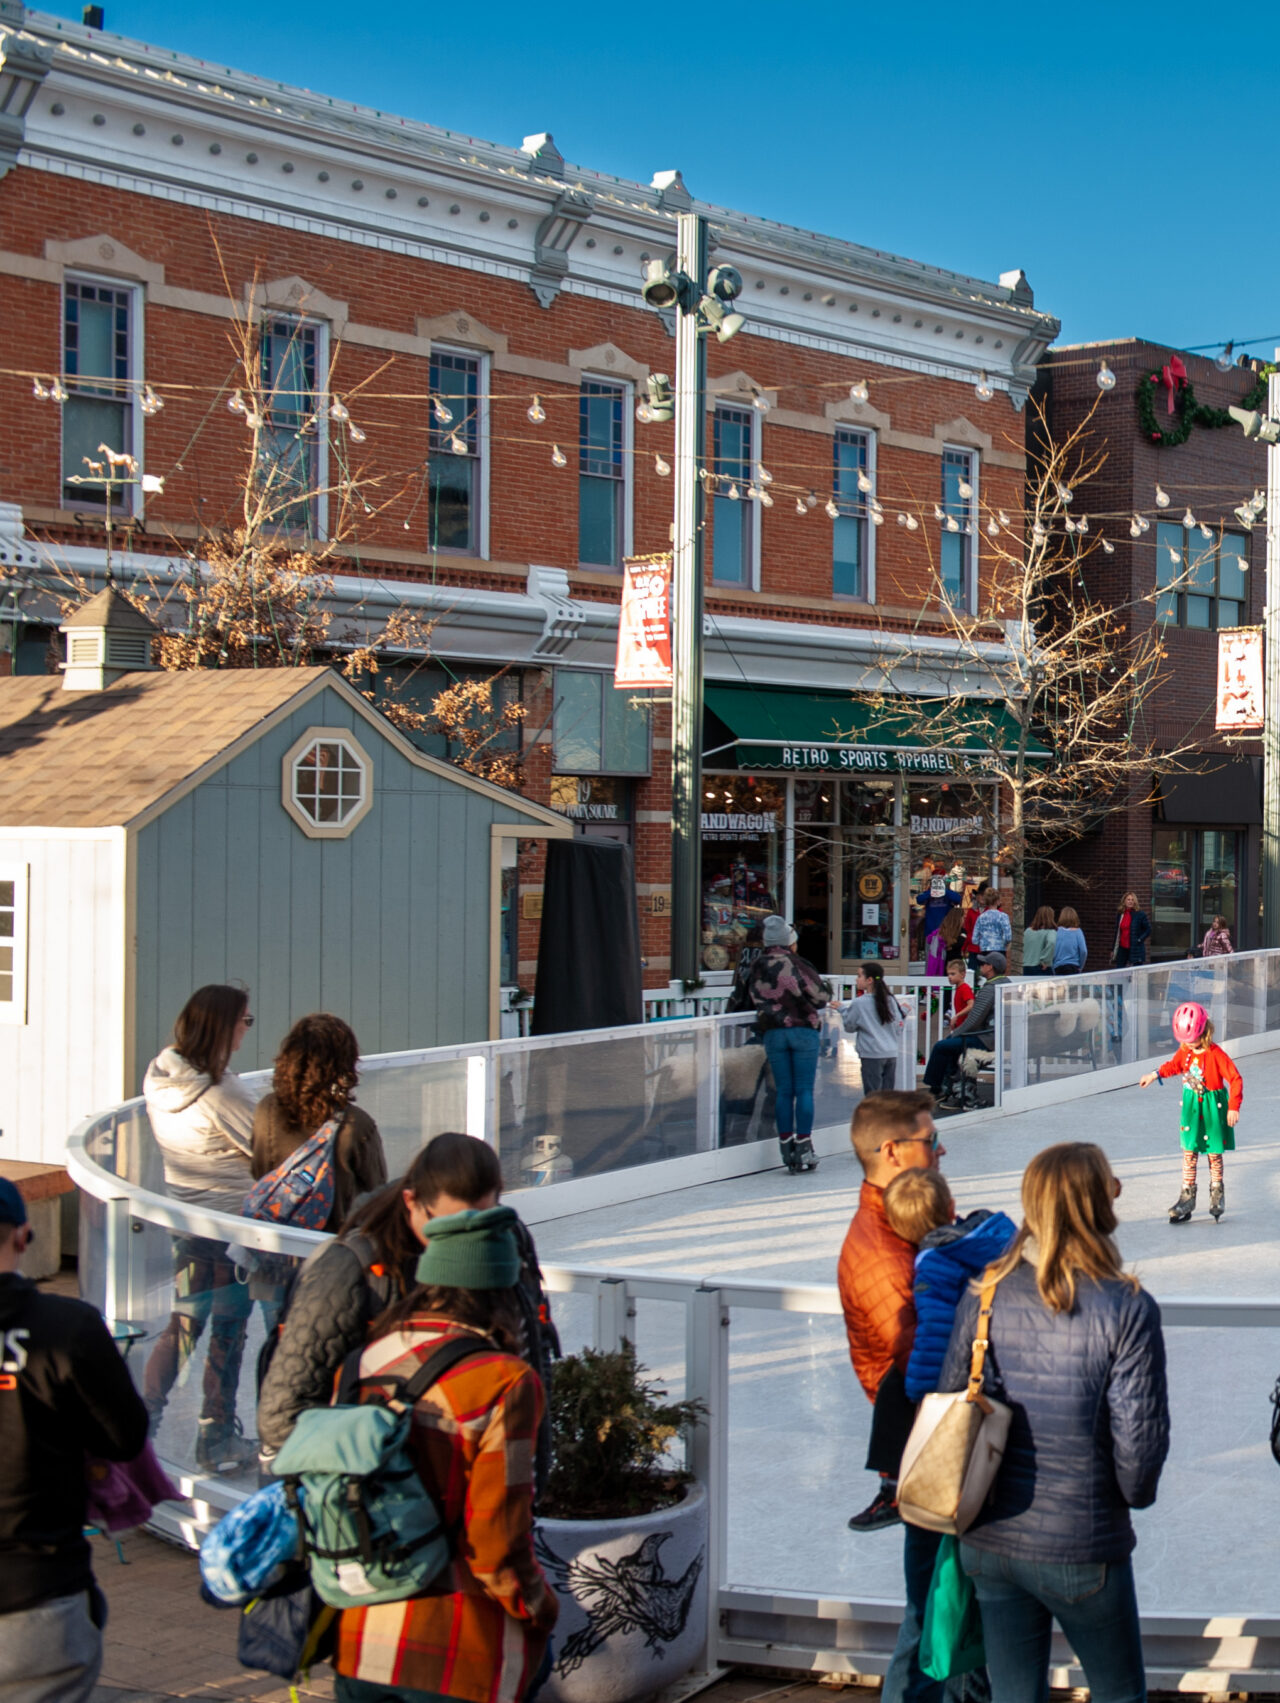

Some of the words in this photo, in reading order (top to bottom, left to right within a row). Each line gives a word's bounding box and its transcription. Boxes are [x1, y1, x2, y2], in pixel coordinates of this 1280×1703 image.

[782, 748, 829, 764] RETRO
[839, 750, 888, 767] SPORTS
[898, 752, 953, 769] APPAREL
[577, 780, 591, 802] 19
[589, 805, 617, 819] SQUARE
[700, 811, 776, 833] ANDWAGON
[653, 896, 665, 912] 19
